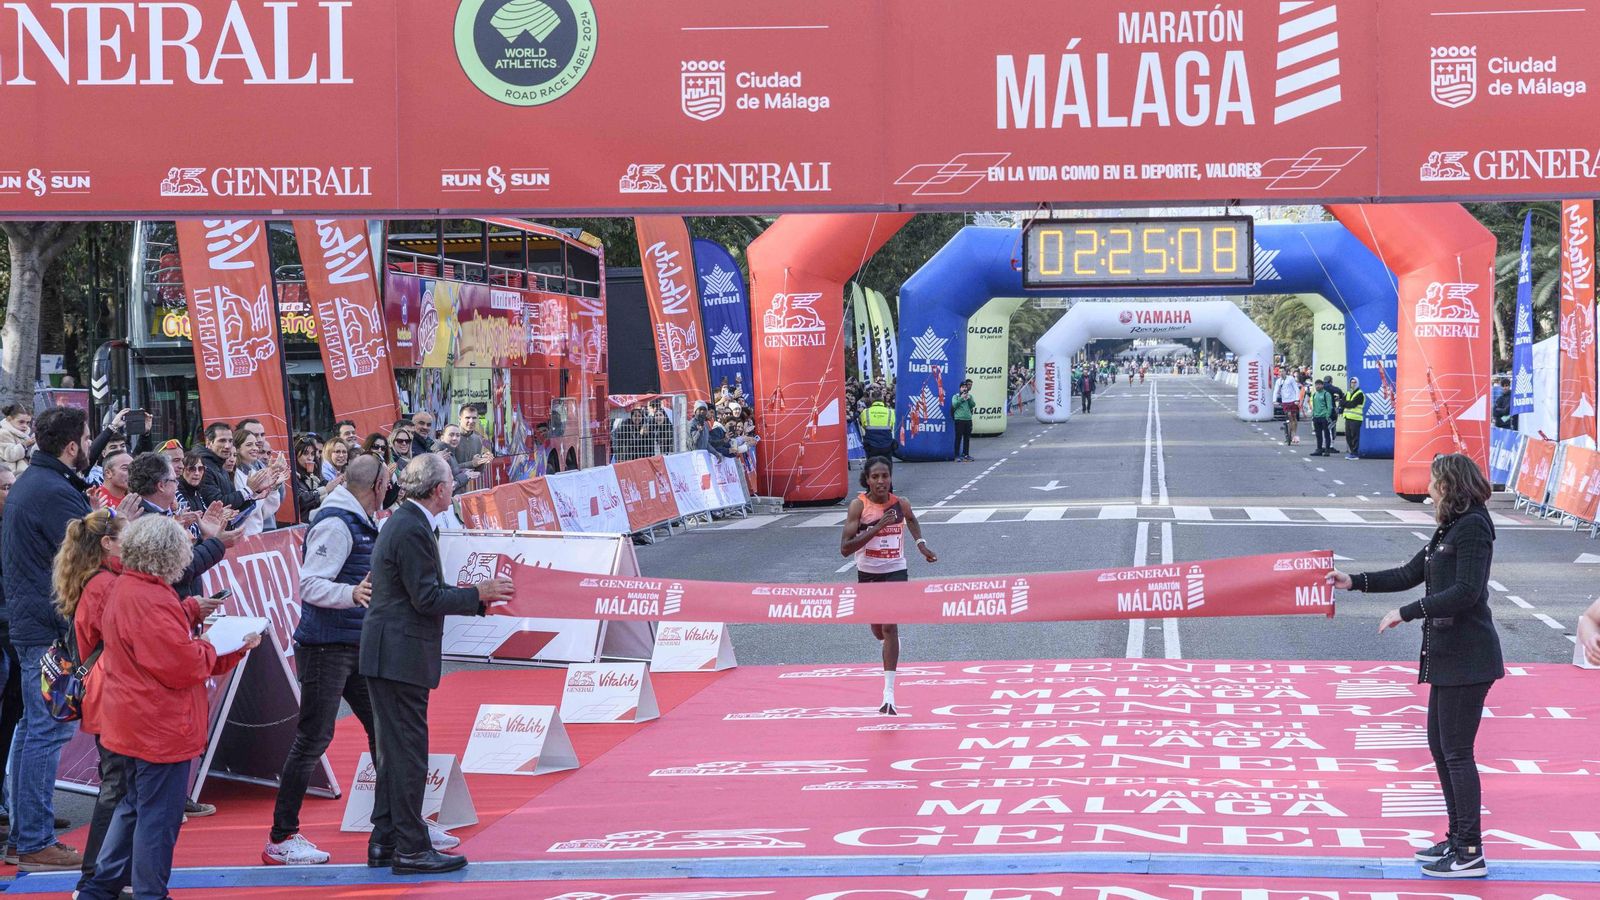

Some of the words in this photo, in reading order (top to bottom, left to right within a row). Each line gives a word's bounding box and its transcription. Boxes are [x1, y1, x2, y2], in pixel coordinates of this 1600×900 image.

[1118, 4, 1244, 44] MARATÓN
[0, 0, 353, 85] NERALI
[505, 48, 547, 58] WORLD
[505, 88, 537, 100] ROAD
[540, 78, 569, 98] RACE
[568, 46, 590, 79] LABEL
[580, 11, 592, 42] 2024
[494, 59, 557, 69] ATHLETICS
[1488, 56, 1556, 74] Ciudad
[736, 71, 801, 89] Ciudad
[996, 38, 1255, 129] MÁLAGA
[1488, 78, 1512, 96] de
[1518, 78, 1587, 97] Málaga
[736, 92, 759, 109] de
[764, 91, 830, 112] Málaga
[211, 166, 372, 197] GENERALI
[441, 174, 481, 187] RUN
[486, 166, 506, 194] &
[510, 173, 550, 186] SUN
[670, 162, 832, 193] GENERALI
[987, 166, 1005, 182] EN
[1008, 166, 1024, 181] LA
[1028, 165, 1057, 181] VIDA
[1061, 164, 1099, 181] COMO
[1103, 164, 1120, 180] EN
[1124, 164, 1138, 180] EL
[1141, 163, 1202, 181] DEPORTE,
[1206, 163, 1262, 179] VALORES
[26, 167, 47, 197] &
[50, 175, 91, 188] SUN
[1039, 226, 1237, 275] 02:25:08
[1135, 310, 1192, 324] YAMAHA
[764, 332, 826, 347] GENERALI
[1414, 324, 1480, 338] GENERALI
[965, 366, 1003, 374] OLDCAR
[1045, 362, 1055, 403] YAMAHA
[1248, 361, 1258, 402] YAMAHA
[906, 419, 946, 432] lanvi
[1294, 556, 1334, 570] GENE
[1117, 567, 1181, 580] GENERALI
[599, 579, 662, 590] GENERALI
[771, 586, 834, 597] GENERALI
[944, 580, 1007, 592] GENERALI
[1148, 581, 1180, 591] MARATÓN
[594, 596, 659, 616] MÁLAGA
[942, 596, 1007, 617] MÁLAGA
[1117, 588, 1184, 612] MÁLAGA
[768, 600, 833, 619] MÁLAGA
[684, 629, 720, 645] Vitality
[598, 672, 639, 692] Vitality
[997, 677, 1300, 685] GENERALI
[505, 715, 546, 738] Vitality
[966, 719, 1309, 730] GENERALI
[355, 783, 376, 791] GENE
[928, 778, 1329, 790] GENERALI
